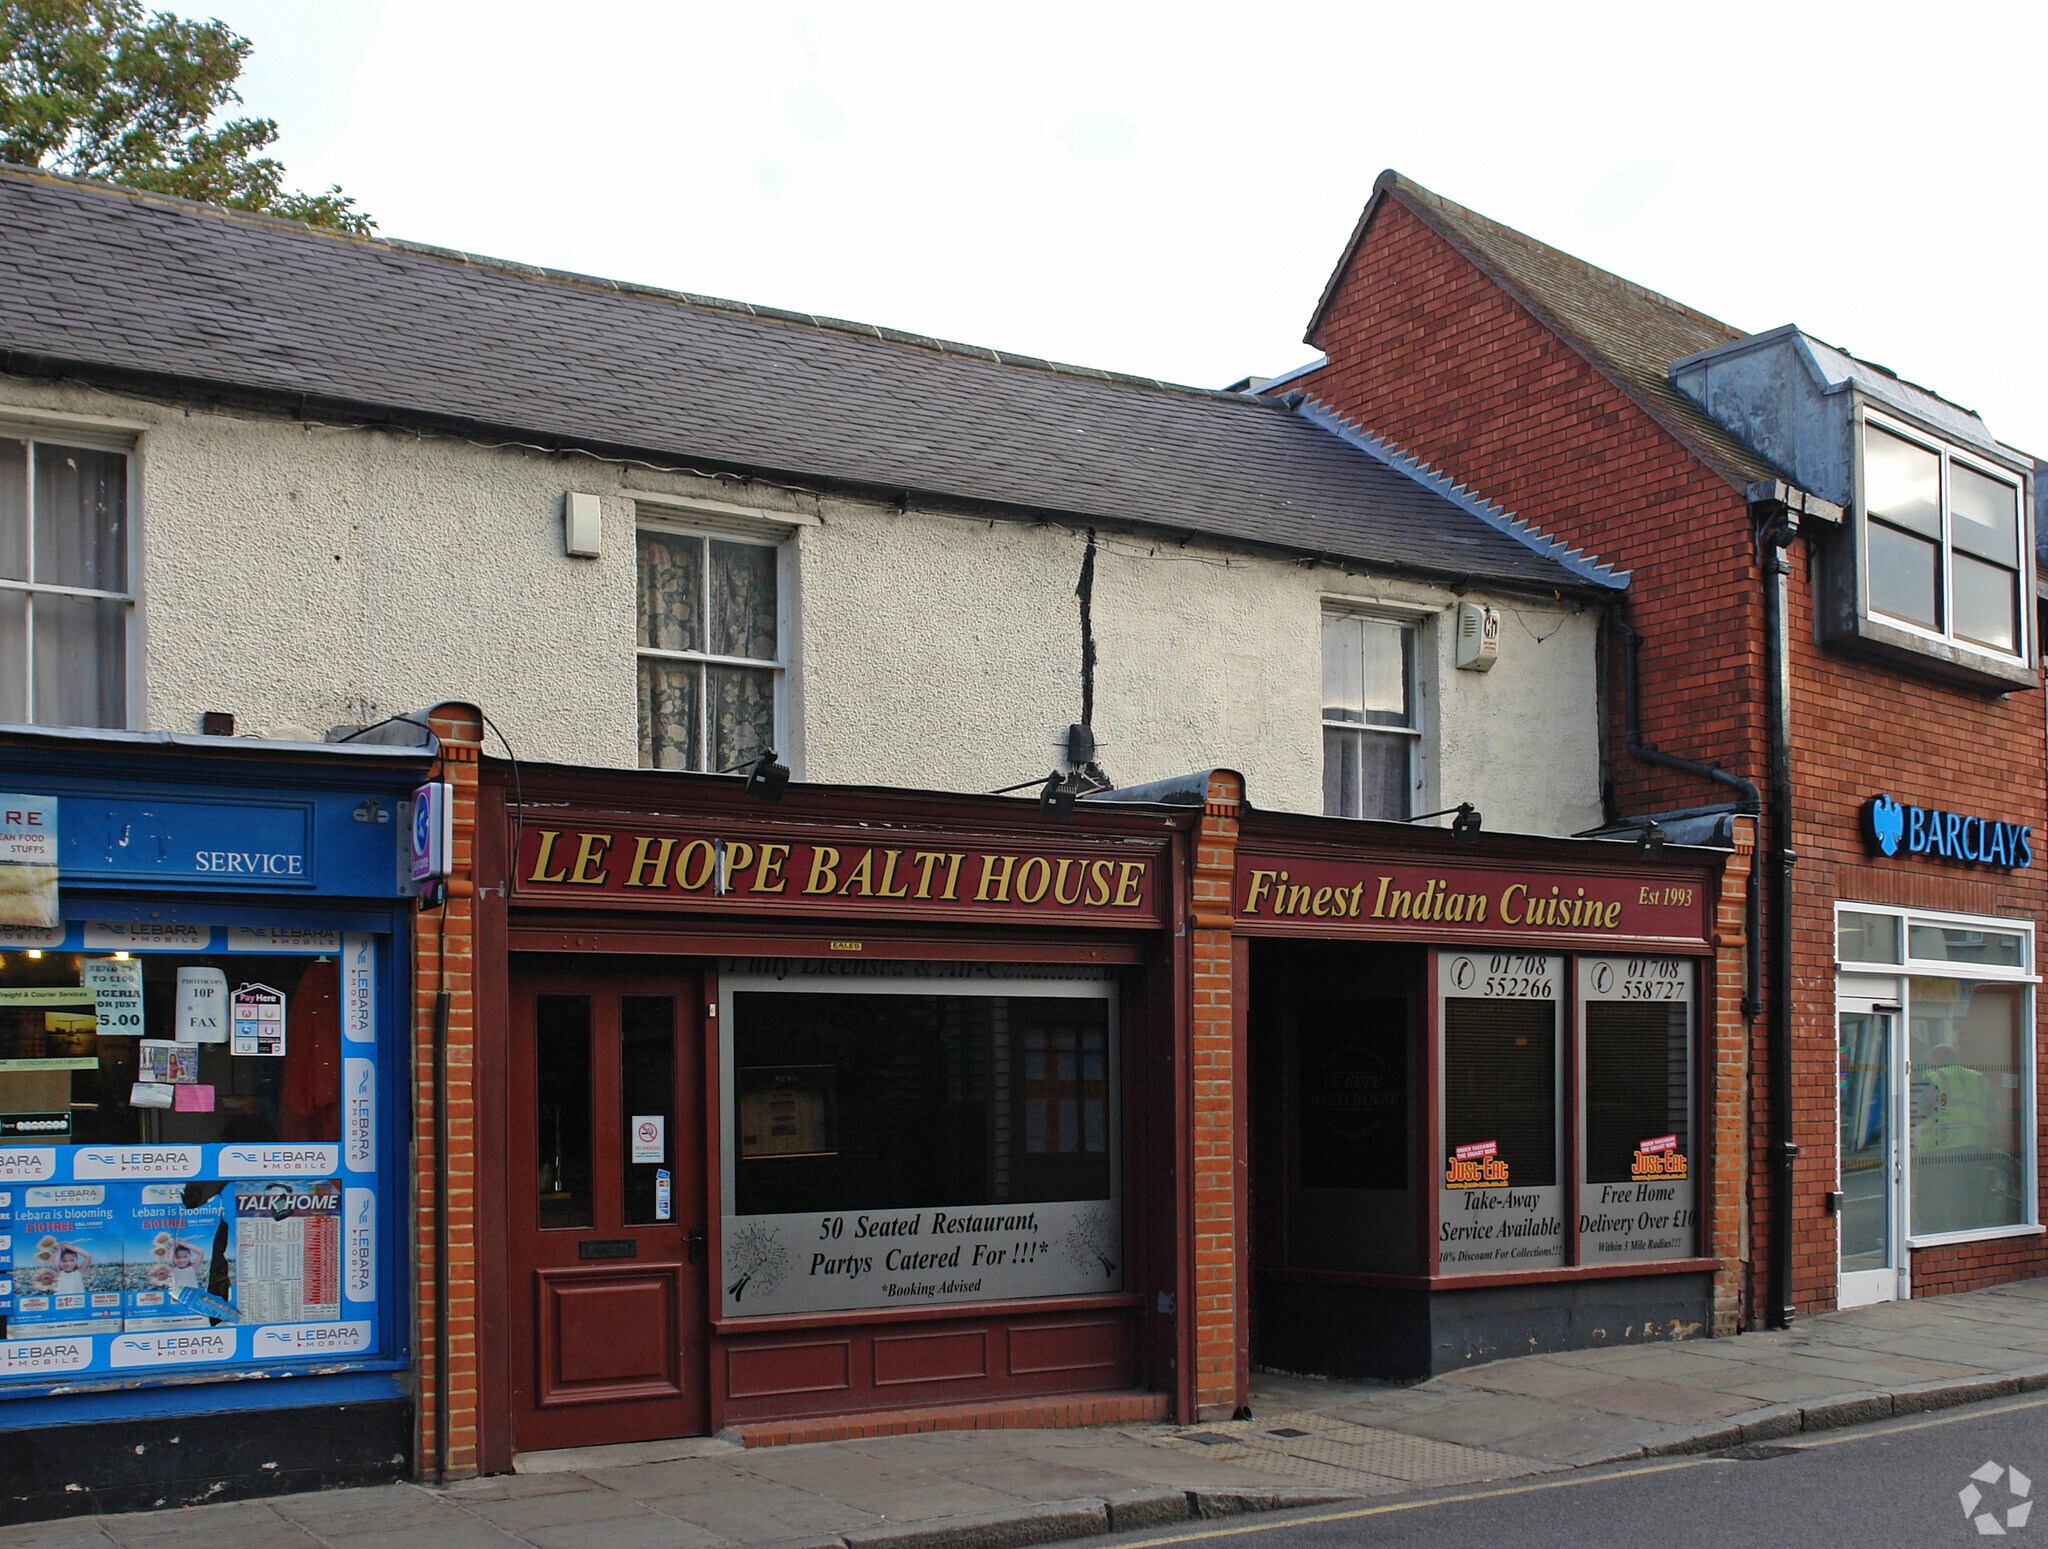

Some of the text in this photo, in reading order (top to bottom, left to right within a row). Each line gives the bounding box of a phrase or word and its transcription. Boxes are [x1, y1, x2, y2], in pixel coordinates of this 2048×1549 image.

[5, 810, 43, 826] RE
[19, 834, 45, 842] FOOD
[1909, 806, 2032, 868] BARCLAYS
[11, 845, 45, 853] STUFFS
[195, 850, 303, 875] SERVICE
[528, 831, 1146, 907] LE HOPE BALTI HOUSE
[1242, 868, 1622, 929] Finest Indian Cuisine
[1638, 885, 1693, 907] Est 1993
[131, 924, 198, 935] LEBARA
[272, 929, 335, 938] LEBARA
[1489, 954, 1546, 976] 01708
[1627, 959, 1680, 979] 01708
[96, 990, 141, 998] IGERIA
[193, 988, 214, 998] 10P
[1484, 977, 1552, 998] 552266
[1622, 980, 1685, 1000] 558727
[240, 993, 277, 1004] Pay Here
[358, 968, 369, 1031] LEBARA
[96, 1014, 140, 1026] 5.00
[190, 1017, 217, 1028] FAX
[358, 1099, 370, 1161] LEBARA
[121, 1153, 189, 1164] LEBARA
[263, 1151, 326, 1162] LEBARA
[1464, 1190, 1540, 1213] Take-Away
[1601, 1184, 1675, 1204] Free Home
[238, 1194, 339, 1211] TALK HOME
[15, 1207, 113, 1221] Lebara is blooming
[132, 1204, 225, 1218] Lebara is blooming
[26, 1222, 46, 1232] £10
[47, 1221, 74, 1231] FREE
[142, 1219, 160, 1229] £10
[162, 1218, 186, 1229] FREE
[819, 1211, 1039, 1240] 50 Seated Restaurant,
[1440, 1216, 1561, 1241] Service Available
[1580, 1214, 1634, 1236] Delivery
[1638, 1211, 1669, 1230] Over
[1598, 1241, 1622, 1253] Within
[1623, 1240, 1629, 1252] 3
[1630, 1240, 1646, 1251] Mile
[359, 1228, 370, 1290] LEBARA
[809, 1252, 873, 1279] Partys
[885, 1245, 961, 1271] Catered
[971, 1244, 1006, 1266] For
[1439, 1251, 1456, 1263] 10%
[1458, 1250, 1493, 1262] Discount
[1495, 1248, 1509, 1259] For
[938, 1279, 982, 1294] Advised
[297, 1326, 359, 1341] LEBARA
[157, 1336, 223, 1350] LEBARA
[306, 1338, 359, 1348] MOBILE
[8, 1345, 79, 1360] LEBARA
[167, 1347, 223, 1356] MOBILE
[18, 1357, 79, 1367] MOBILE
